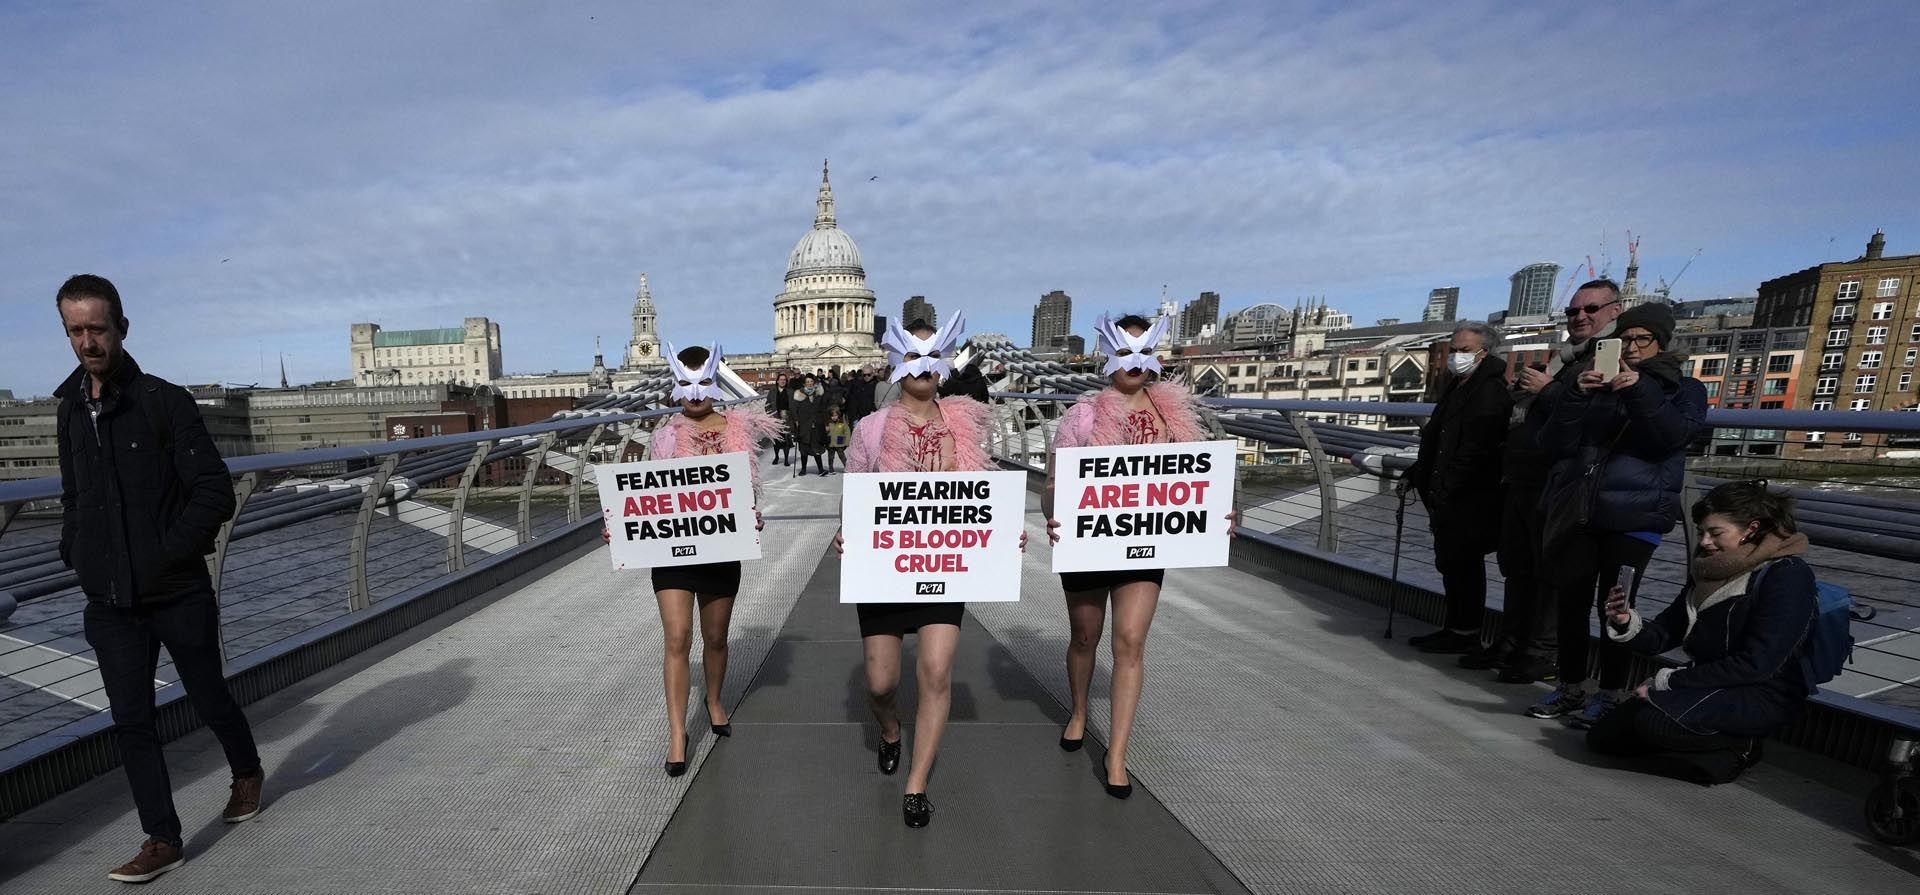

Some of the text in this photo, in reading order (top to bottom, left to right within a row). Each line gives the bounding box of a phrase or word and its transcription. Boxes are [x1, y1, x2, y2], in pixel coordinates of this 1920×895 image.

[616, 464, 730, 491] FEATHERS
[1079, 453, 1212, 478] FEATHERS
[623, 488, 732, 517] ARE NOT
[879, 480, 990, 500] WEARING
[1078, 481, 1210, 509] ARE NOT
[625, 513, 737, 541] FASHION
[875, 505, 992, 525] FEATHERS
[1077, 510, 1207, 538] FASHION
[873, 529, 992, 549] IS BLOODY
[894, 554, 968, 573] CRUEL
